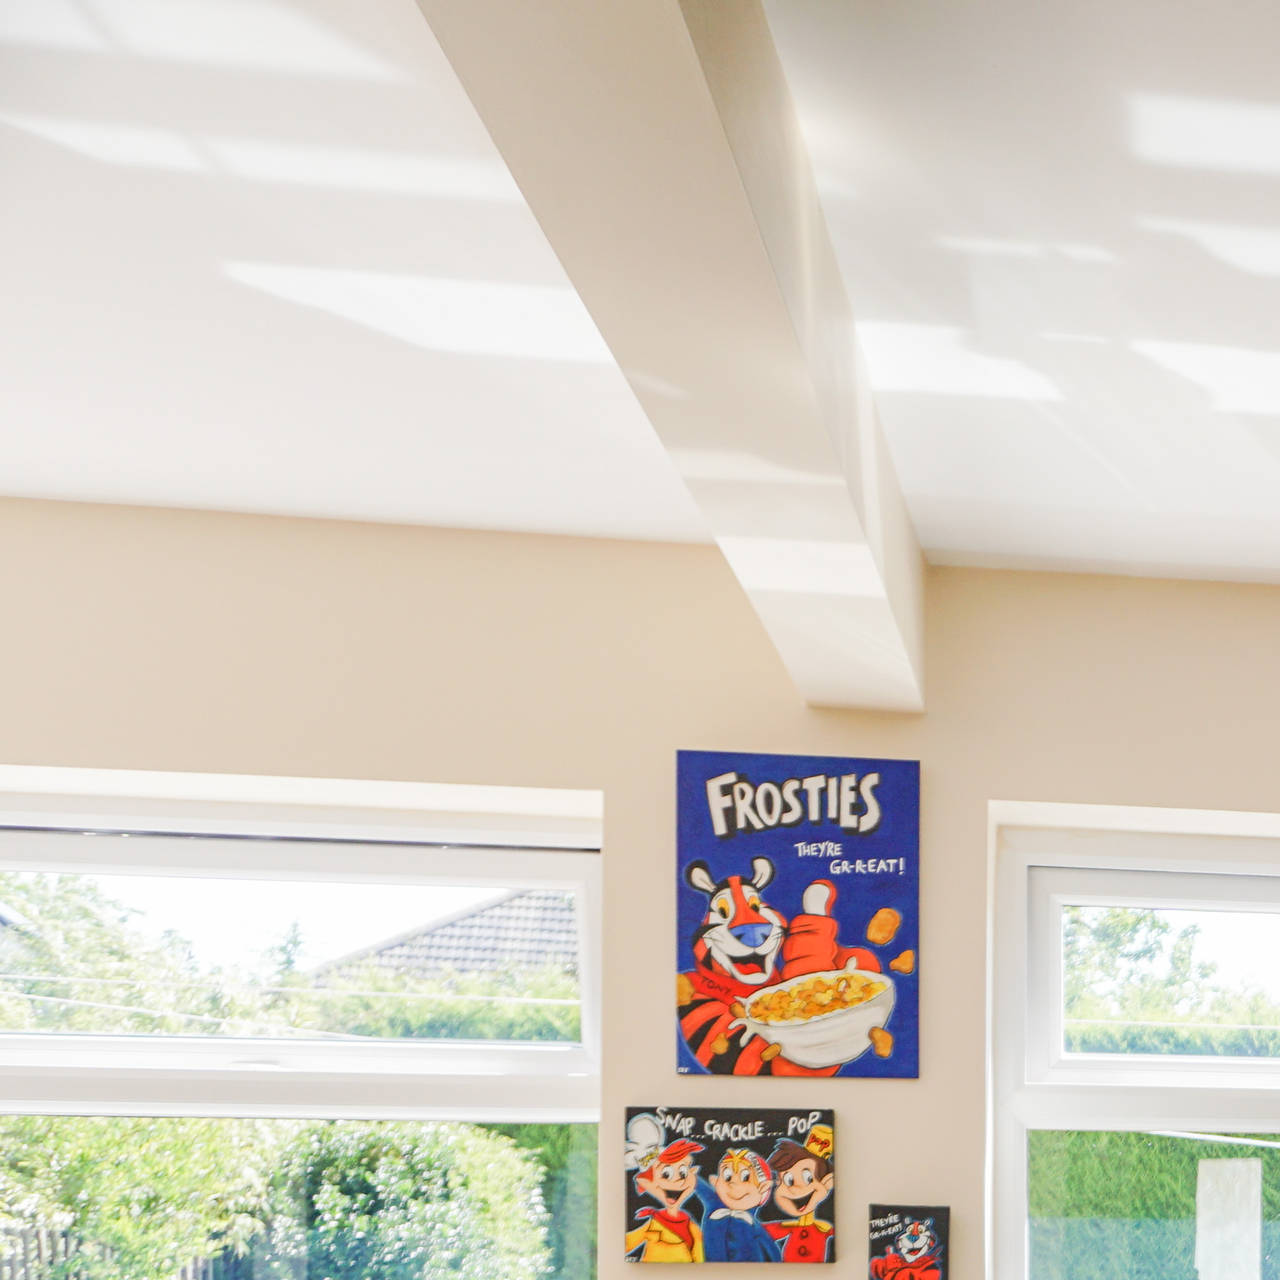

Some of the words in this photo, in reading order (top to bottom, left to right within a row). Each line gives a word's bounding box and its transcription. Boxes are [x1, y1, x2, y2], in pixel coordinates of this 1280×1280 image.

[706, 771, 882, 837] FROSTIES
[794, 841, 843, 858] THEY'RE
[787, 1111, 823, 1137] POP
